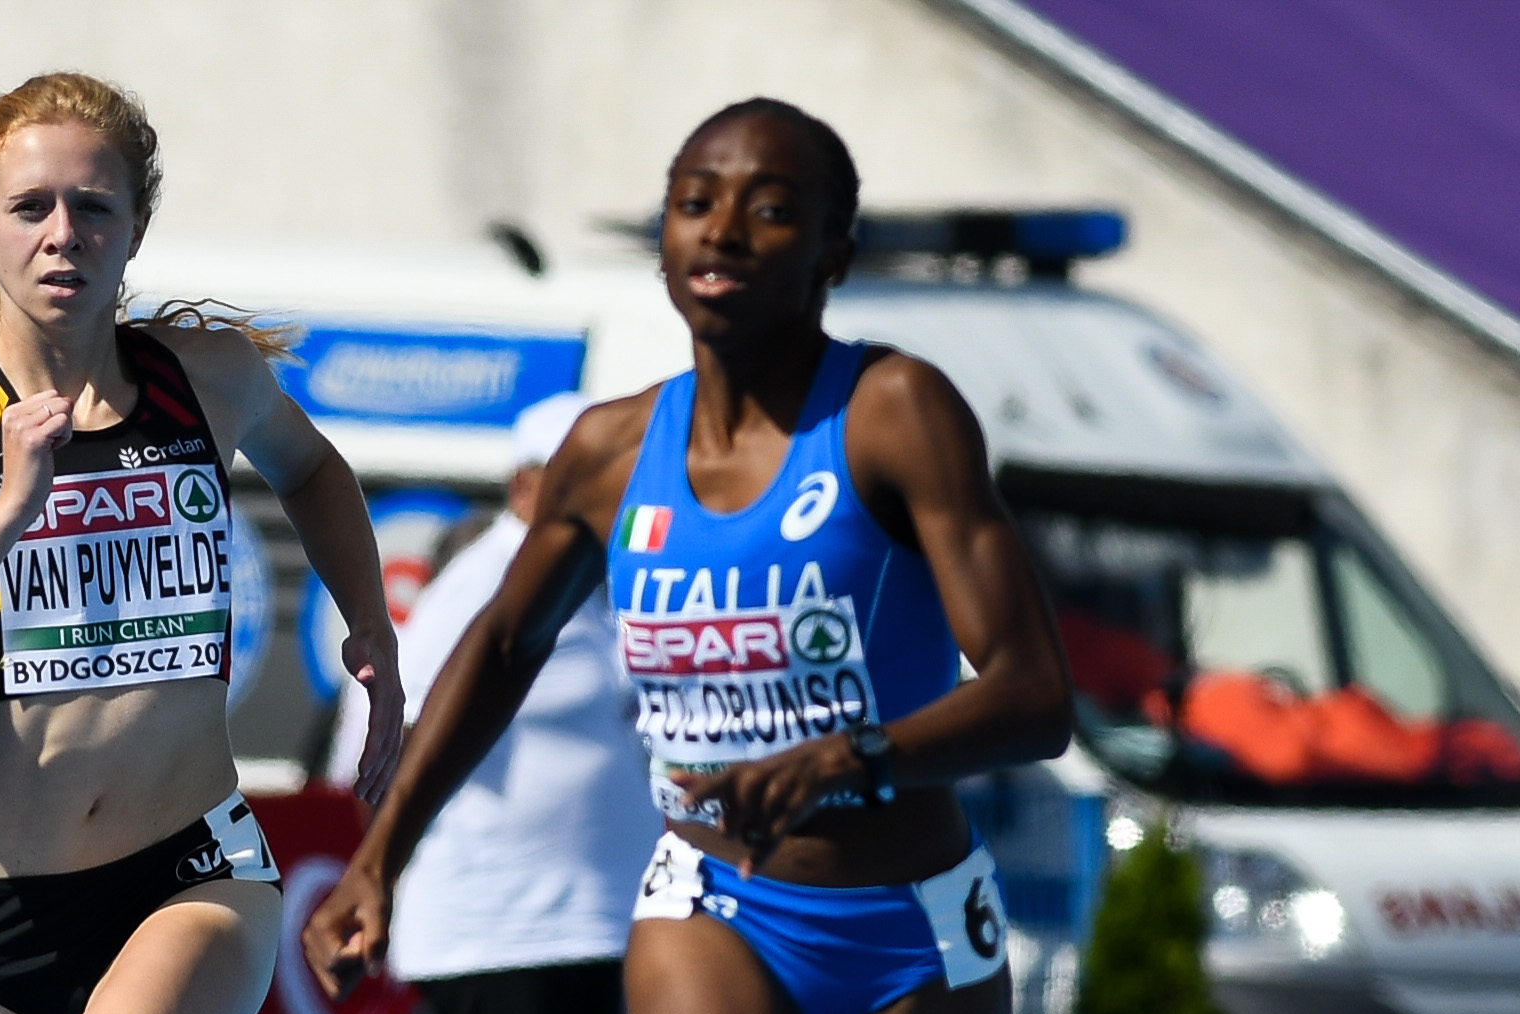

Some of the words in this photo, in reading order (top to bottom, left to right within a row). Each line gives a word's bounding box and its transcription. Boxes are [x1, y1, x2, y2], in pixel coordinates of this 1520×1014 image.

[142, 437, 206, 463] Crelan
[2, 544, 70, 612] VAN
[78, 529, 230, 609] PUYVELDE
[631, 560, 828, 617] ITALIA
[60, 628, 66, 646] I
[72, 624, 113, 646] RUN
[626, 621, 784, 669] SPAR
[12, 646, 183, 685] BYDGOSZCZ
[963, 877, 1000, 959] 6
